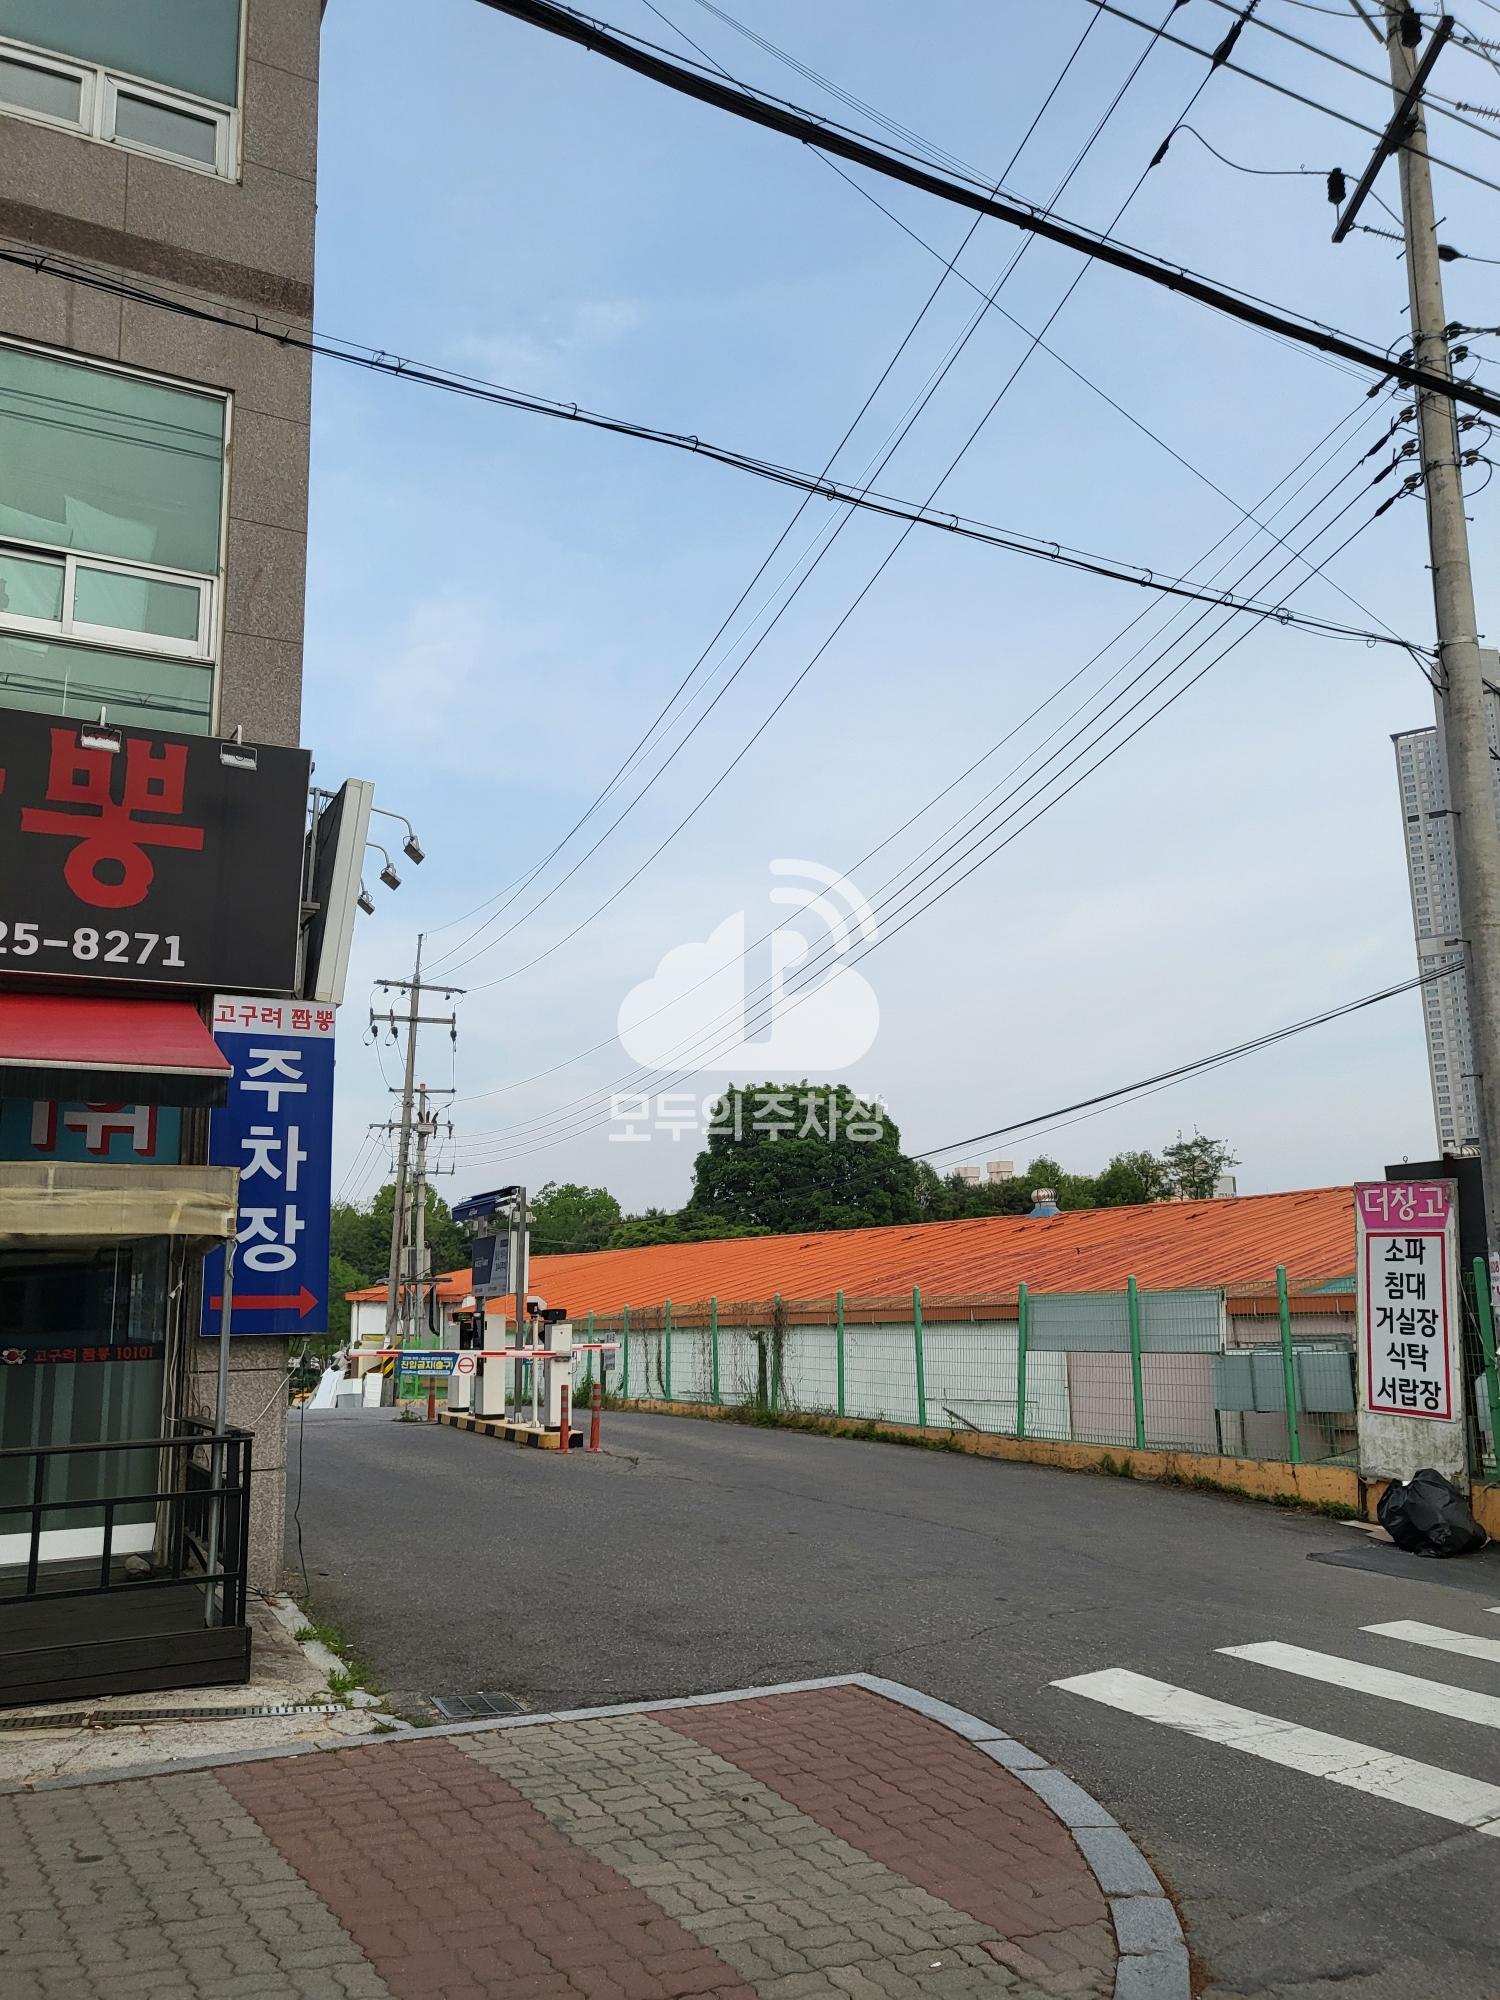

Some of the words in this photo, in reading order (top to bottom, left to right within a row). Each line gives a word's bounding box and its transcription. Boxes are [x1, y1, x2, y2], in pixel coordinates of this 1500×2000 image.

[214, 1004, 283, 1029] 고구려
[291, 1008, 336, 1032] 짬뽕
[235, 1048, 308, 1273] 주차장
[1363, 1186, 1445, 1222] 더창고
[1384, 1237, 1426, 1266] 소파
[1384, 1271, 1426, 1301] 침대
[1376, 1306, 1439, 1338] 거실장
[1386, 1342, 1429, 1373] 식탁
[1377, 1376, 1442, 1411] 서랍장
